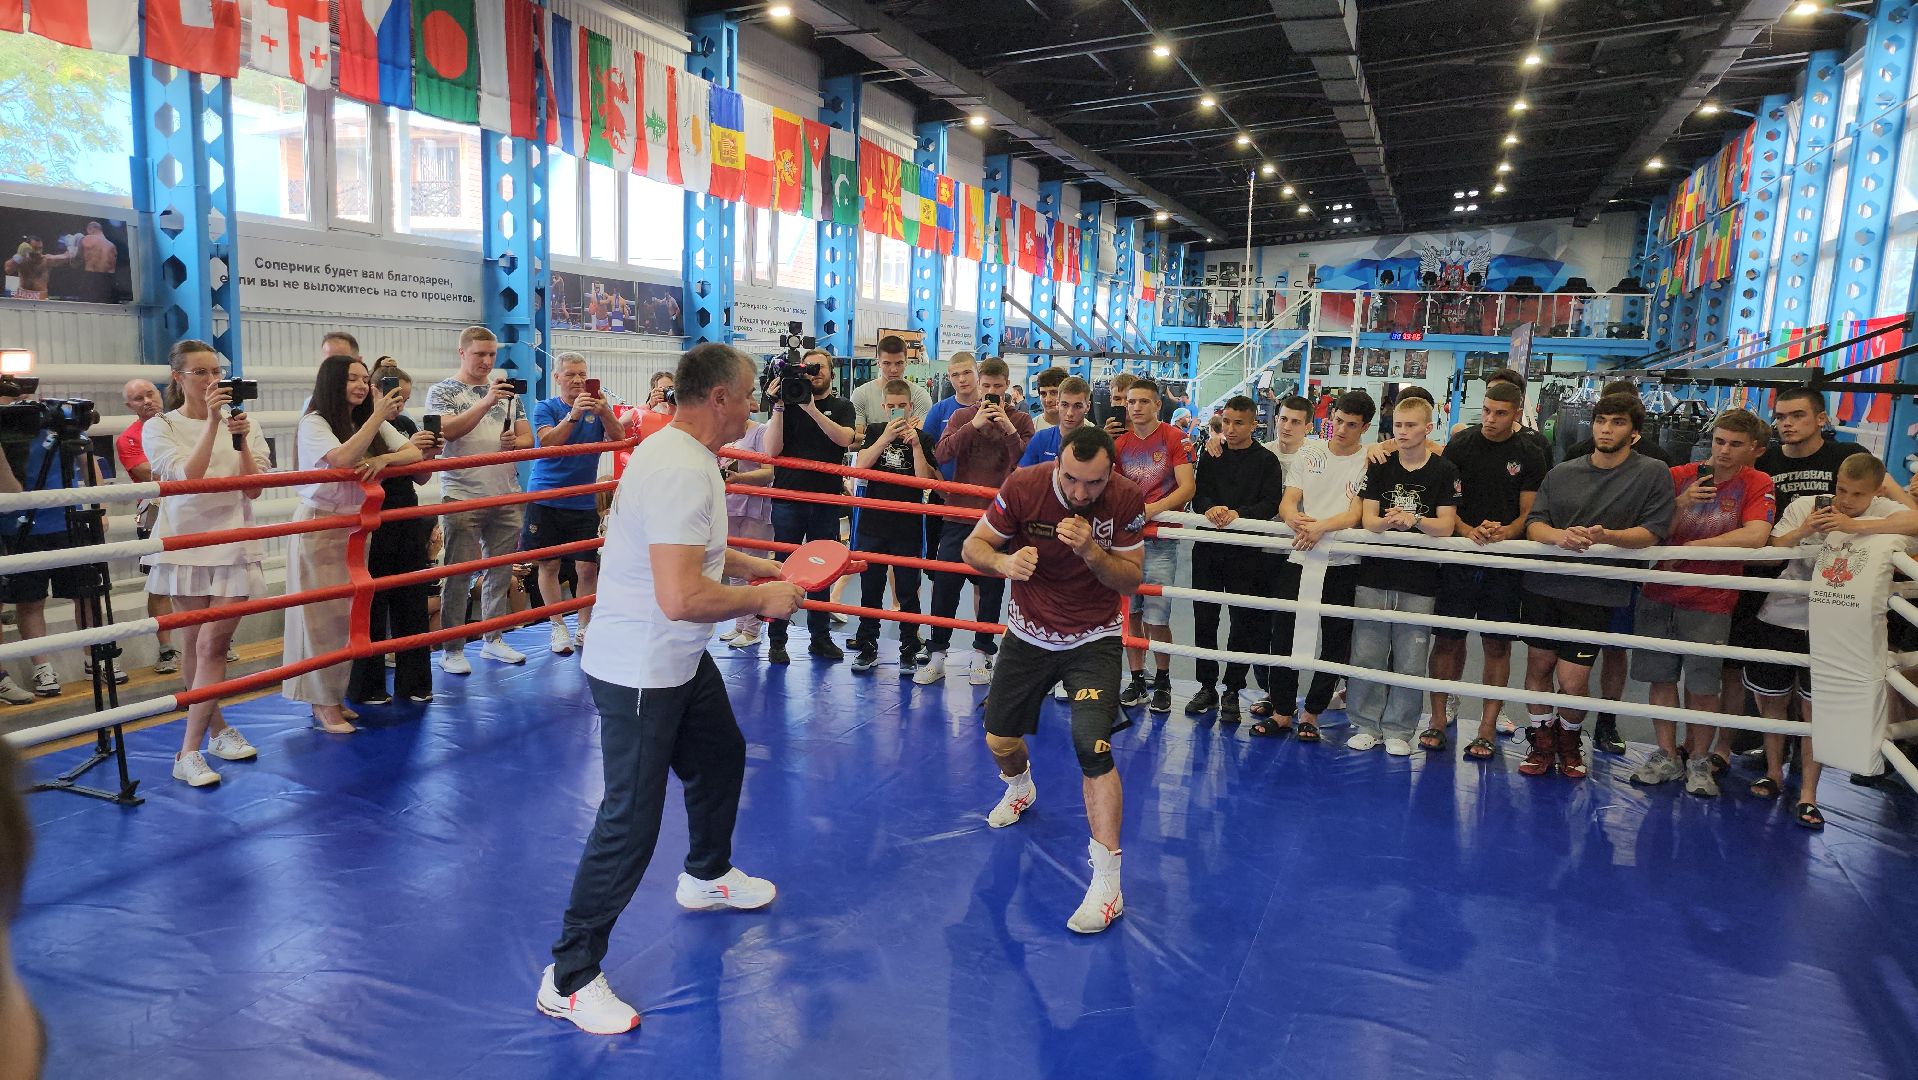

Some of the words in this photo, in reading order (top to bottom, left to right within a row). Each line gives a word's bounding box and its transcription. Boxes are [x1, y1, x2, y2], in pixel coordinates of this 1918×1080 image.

[254, 256, 321, 274] Соперник
[324, 263, 359, 279] будет
[361, 269, 384, 280] вам
[388, 270, 454, 289] благодарен,
[220, 275, 256, 286] ели
[260, 278, 279, 288] вы
[283, 280, 300, 290] не
[303, 281, 380, 296] выложитесь
[383, 288, 398, 297] на
[400, 289, 419, 299] сто
[421, 291, 476, 303] процентов.
[1771, 470, 1833, 483] ПОРТИВНАЯ
[1777, 481, 1830, 492] ДЕРАЦИЯ
[1813, 590, 1856, 600] ФЕДЕРАЦИЯ
[1831, 599, 1860, 608] РОССИИ
